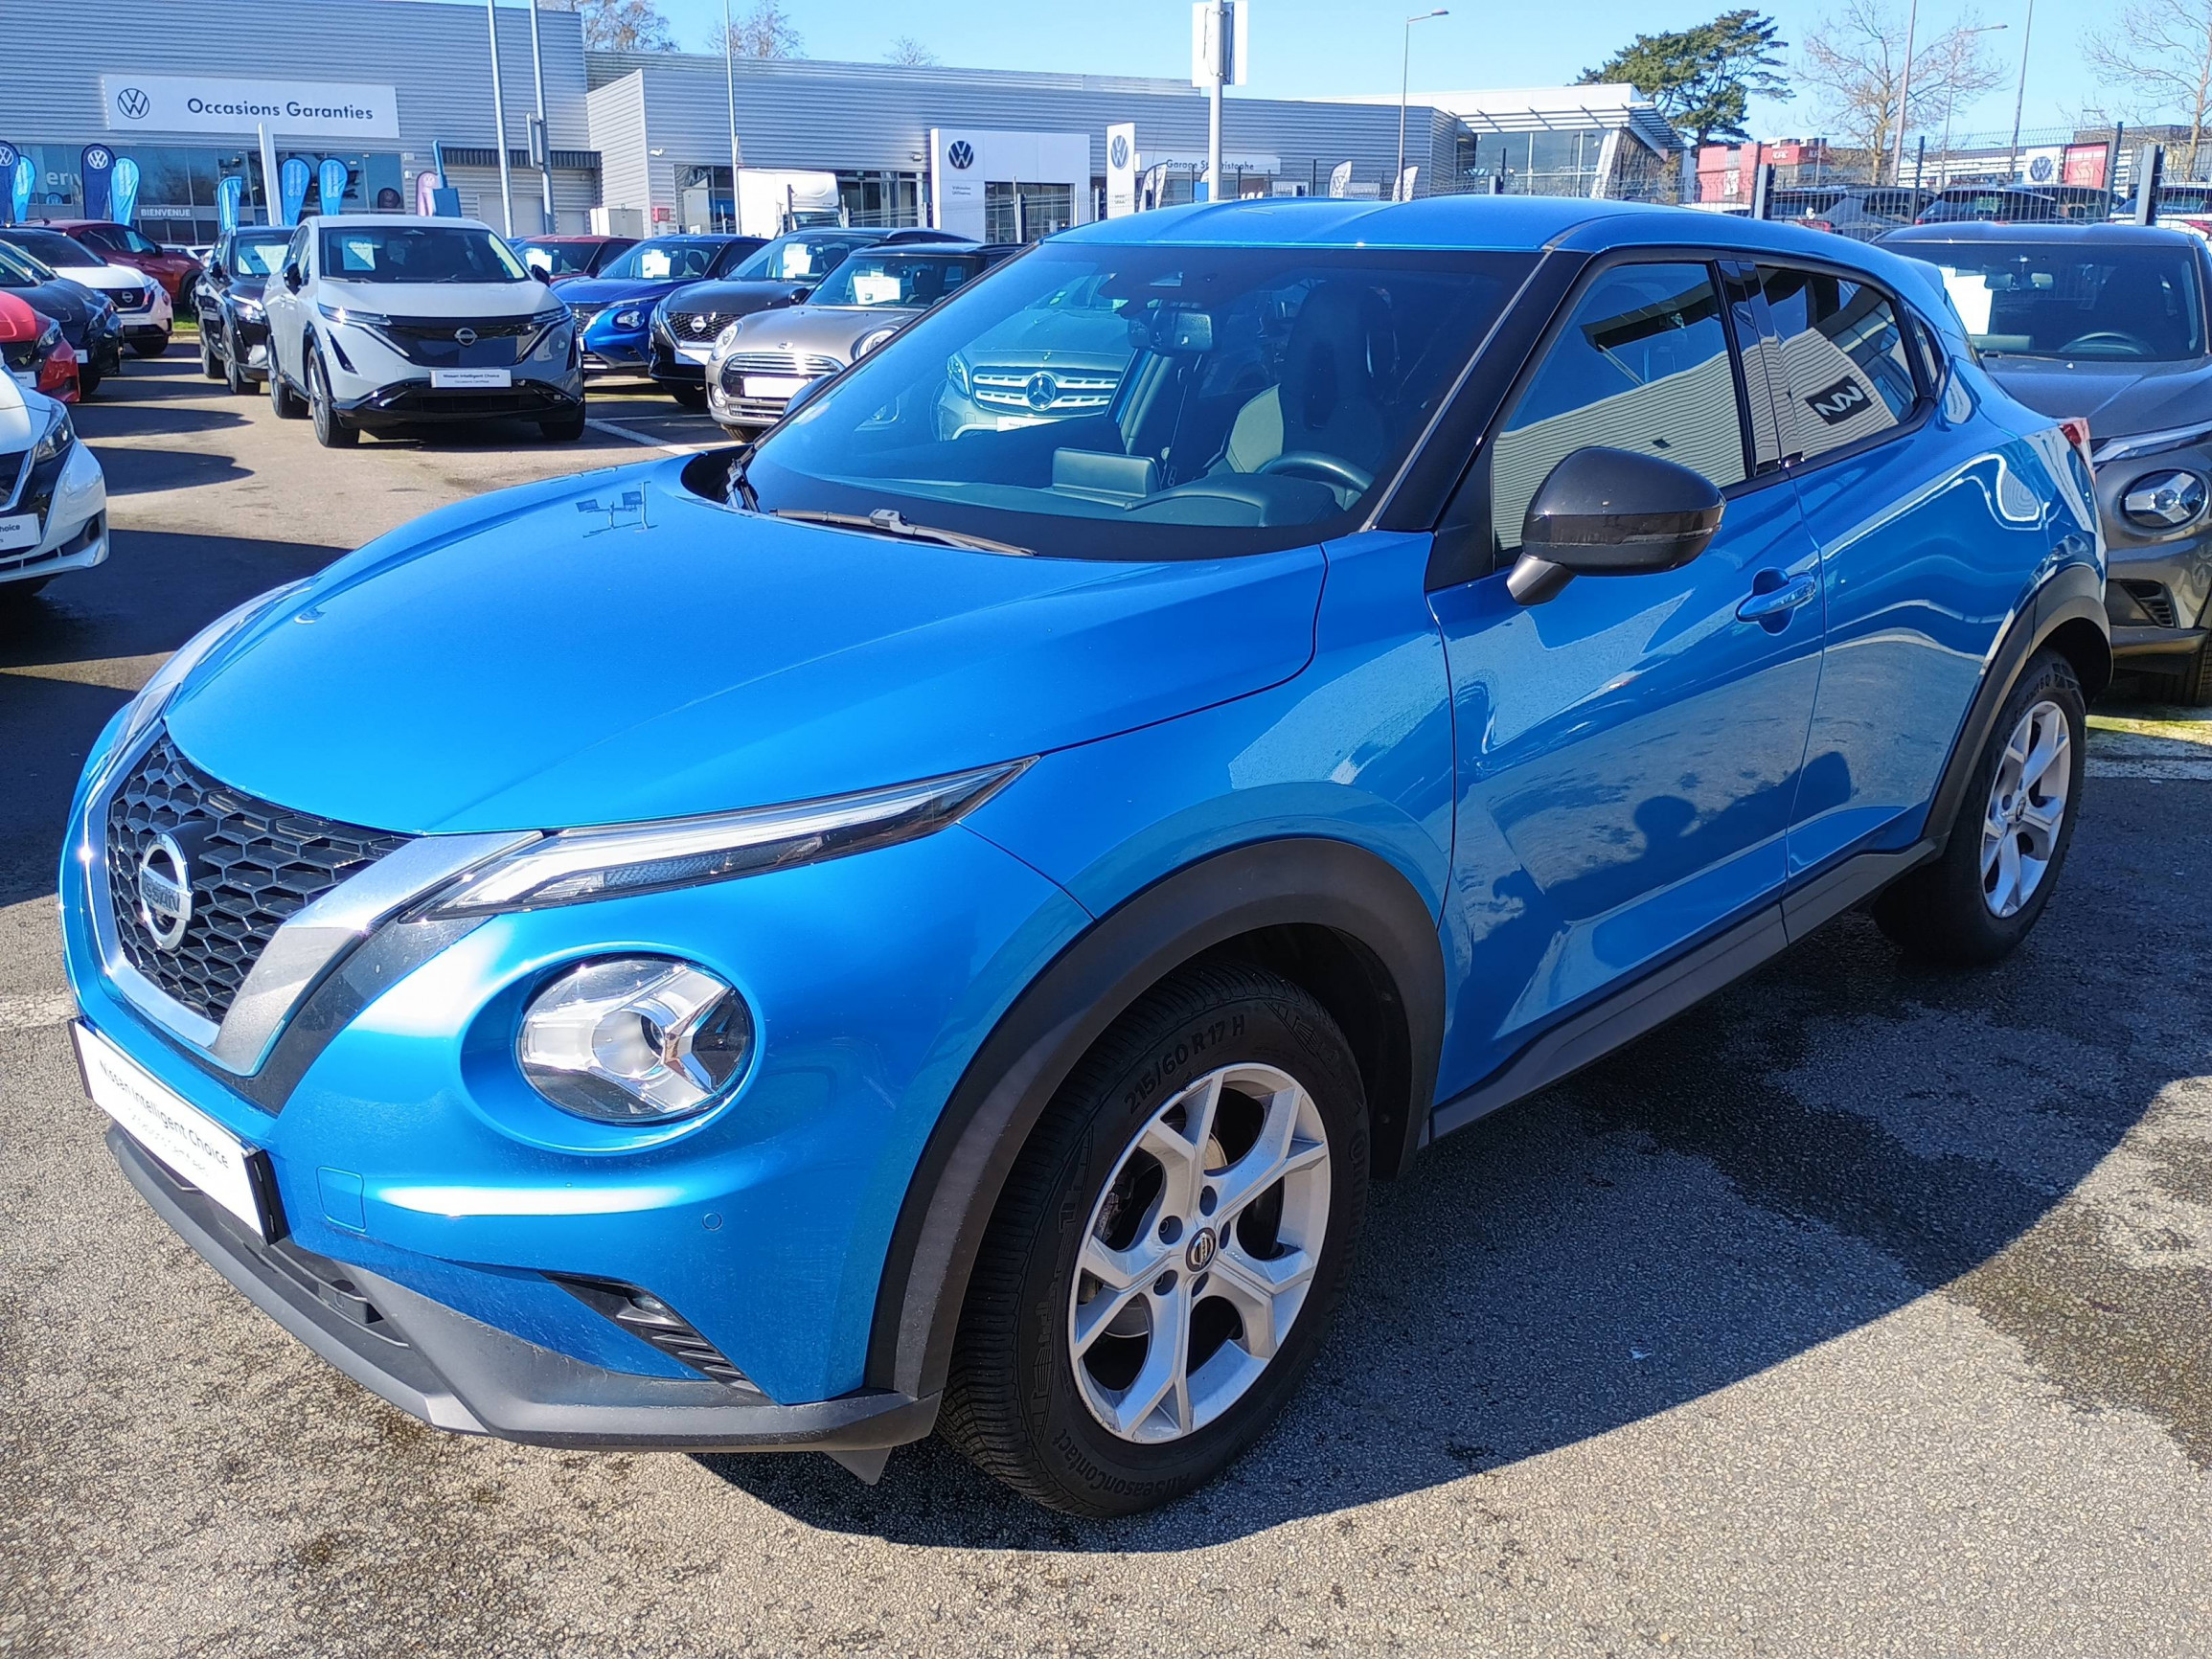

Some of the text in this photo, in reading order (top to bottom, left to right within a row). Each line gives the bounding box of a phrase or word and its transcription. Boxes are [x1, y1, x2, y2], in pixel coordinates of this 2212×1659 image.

[187, 97, 374, 121] Occasions Garanties
[1166, 159, 1198, 170] Garage
[140, 208, 192, 217] BIENVENUE
[1124, 1014, 1245, 1115] 215/60 R 17 H
[100, 1059, 129, 1094] Nissan
[131, 1085, 185, 1140] Intelligent
[189, 1128, 230, 1169] Choice
